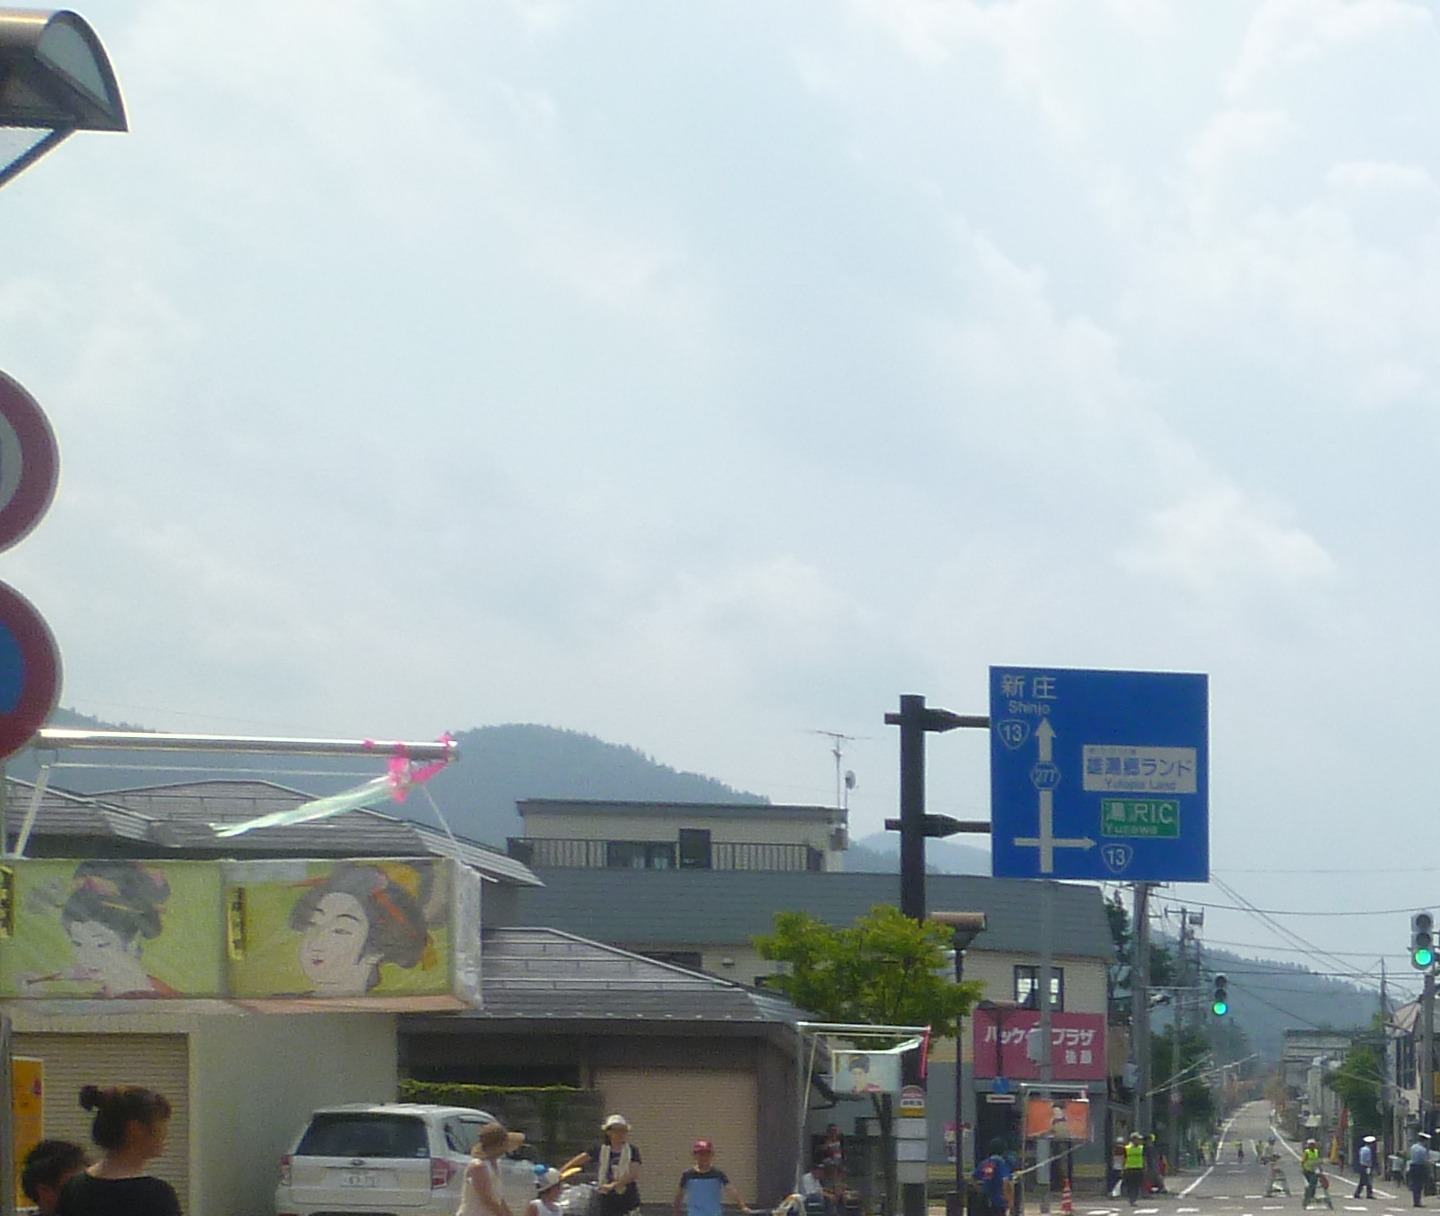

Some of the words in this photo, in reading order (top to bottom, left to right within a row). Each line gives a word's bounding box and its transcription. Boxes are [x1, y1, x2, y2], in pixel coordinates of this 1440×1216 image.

[1001, 674, 1058, 700] 新庄
[1008, 700, 1050, 716] Shinjo
[1003, 724, 1022, 742] 13
[1107, 849, 1126, 866] 13
